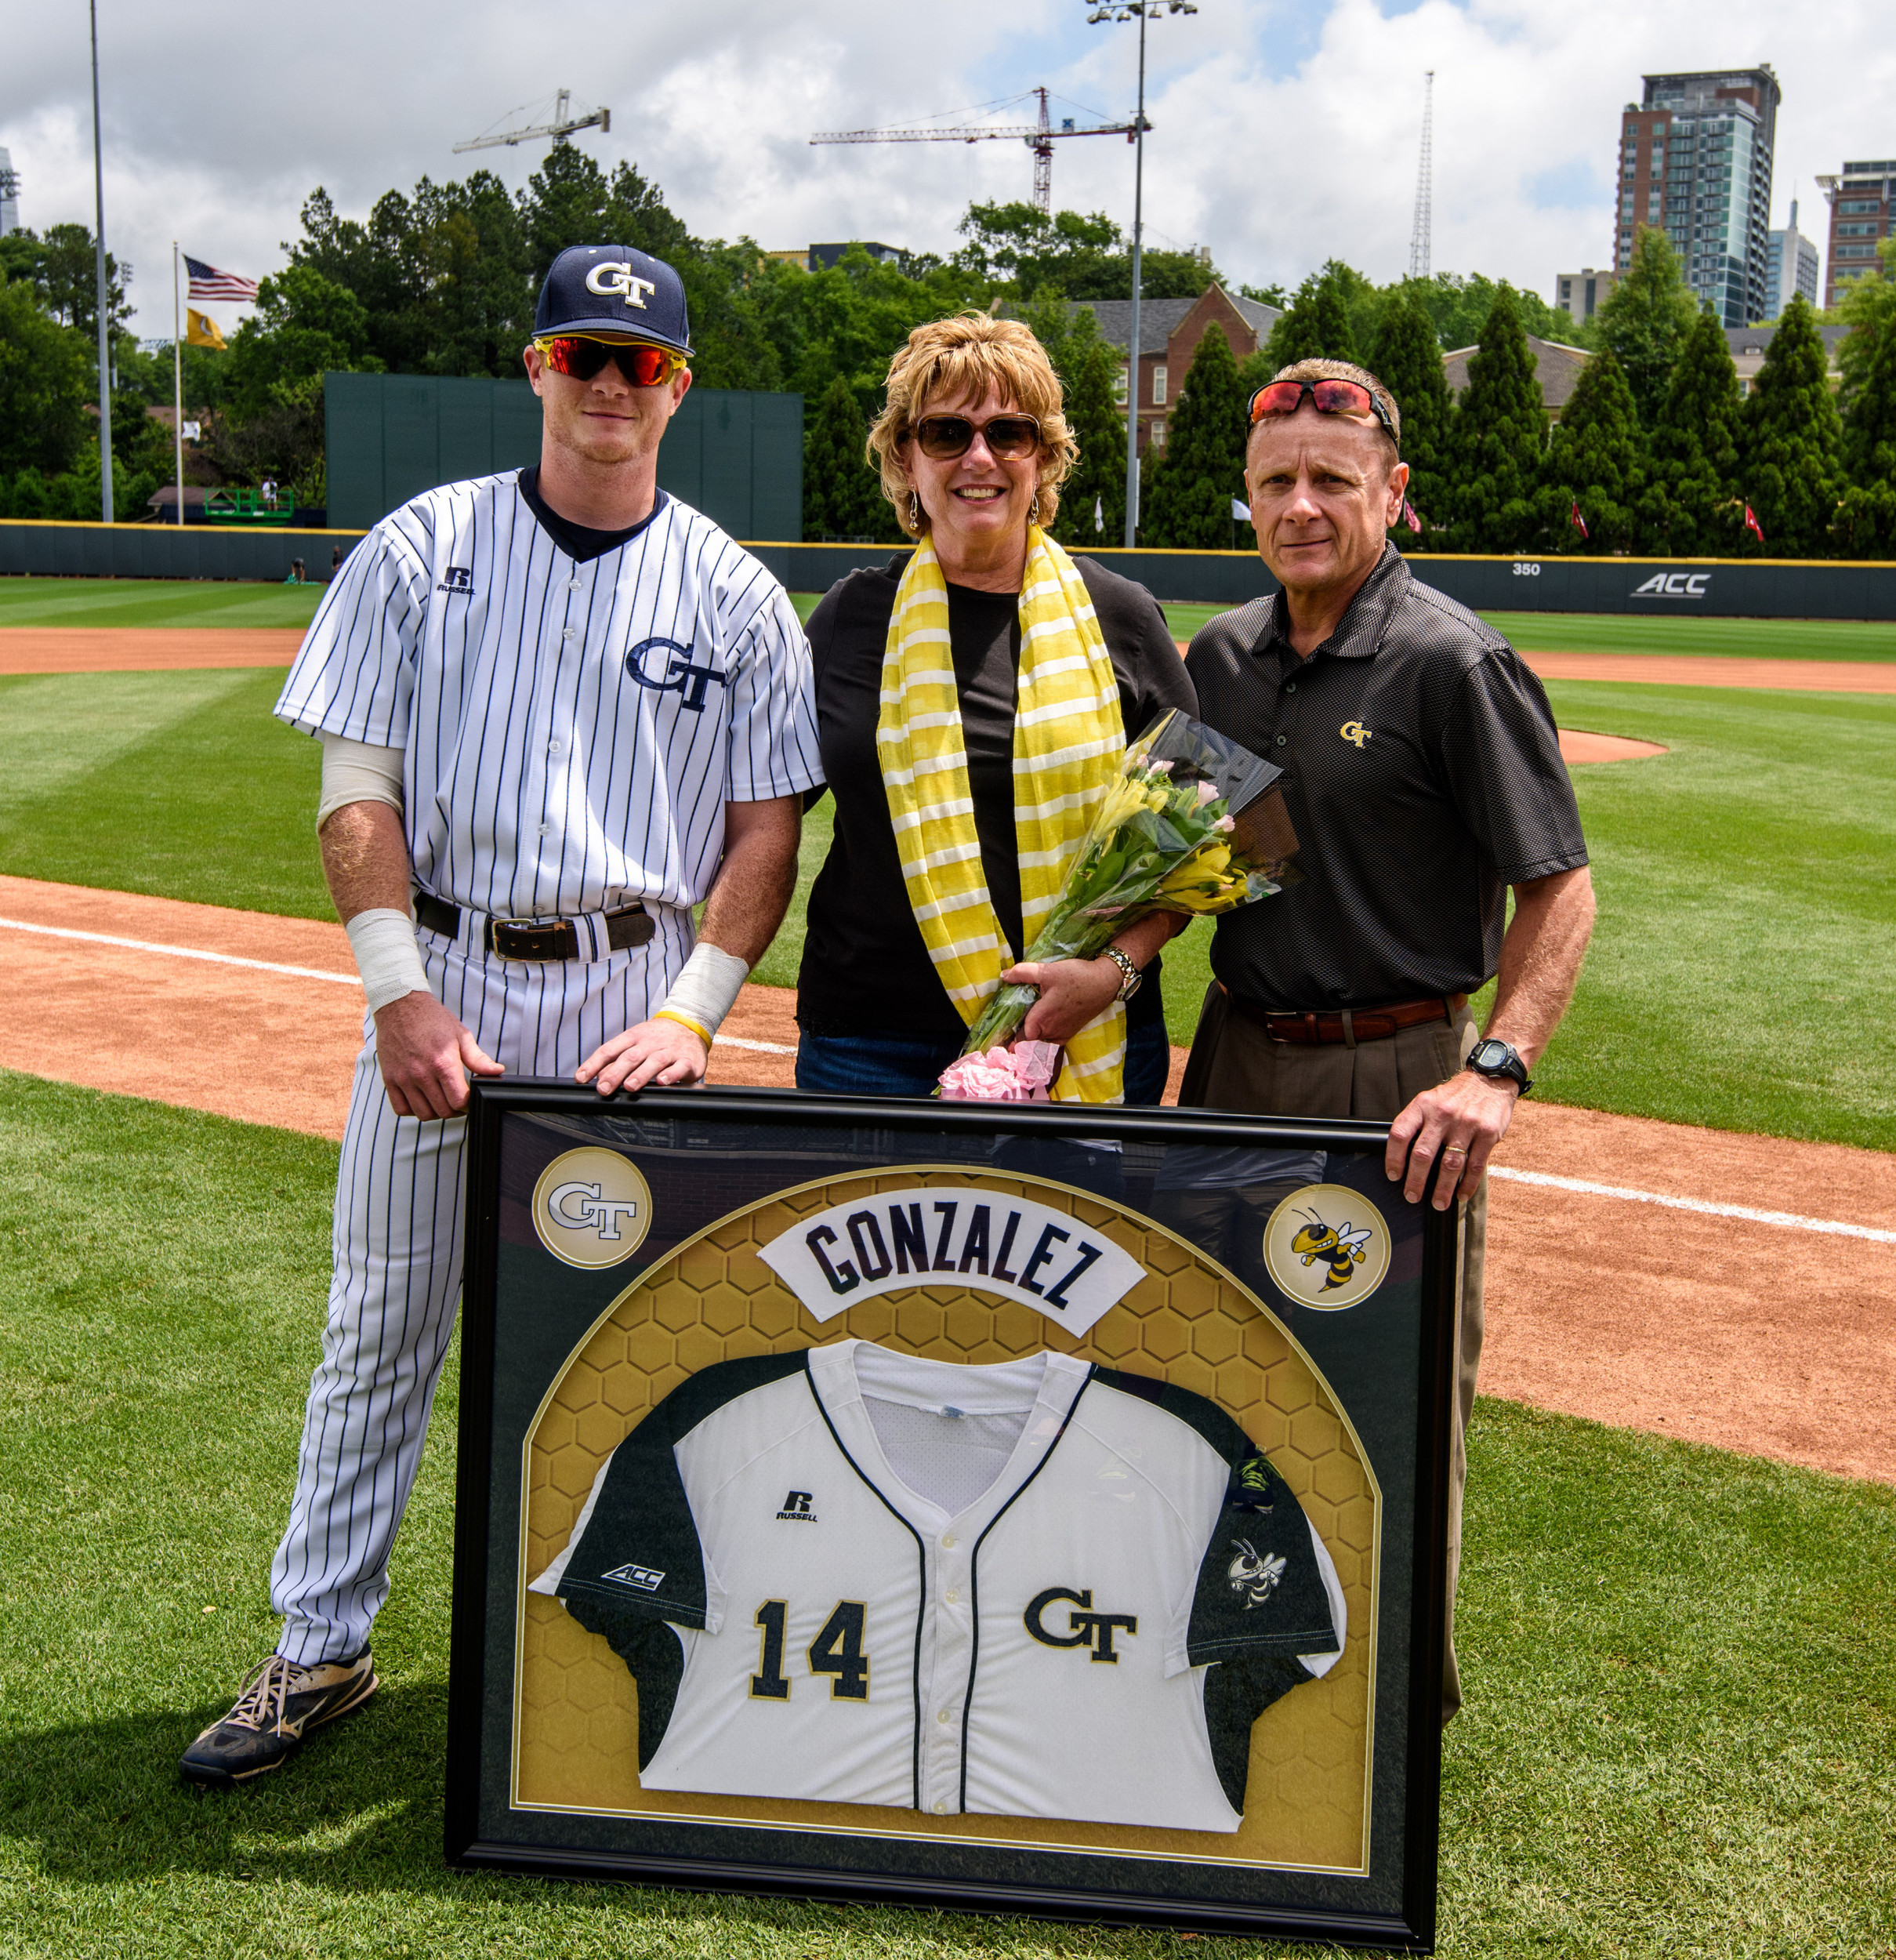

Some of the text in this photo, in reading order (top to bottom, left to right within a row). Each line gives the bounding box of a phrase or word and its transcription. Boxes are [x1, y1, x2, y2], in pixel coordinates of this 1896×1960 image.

[585, 262, 655, 309] GT
[1512, 563, 1541, 576] 350
[1636, 572, 1712, 594] ACC
[437, 584, 476, 595] RUSSELL
[625, 637, 727, 713] GT
[1340, 721, 1372, 748] GT
[548, 1181, 636, 1240] GT
[806, 1201, 1104, 1311] GONZALEZ
[776, 1512, 817, 1523] RUSSELL
[608, 1565, 663, 1586] ACC
[1023, 1585, 1138, 1665] GT
[748, 1599, 870, 1703] 14
